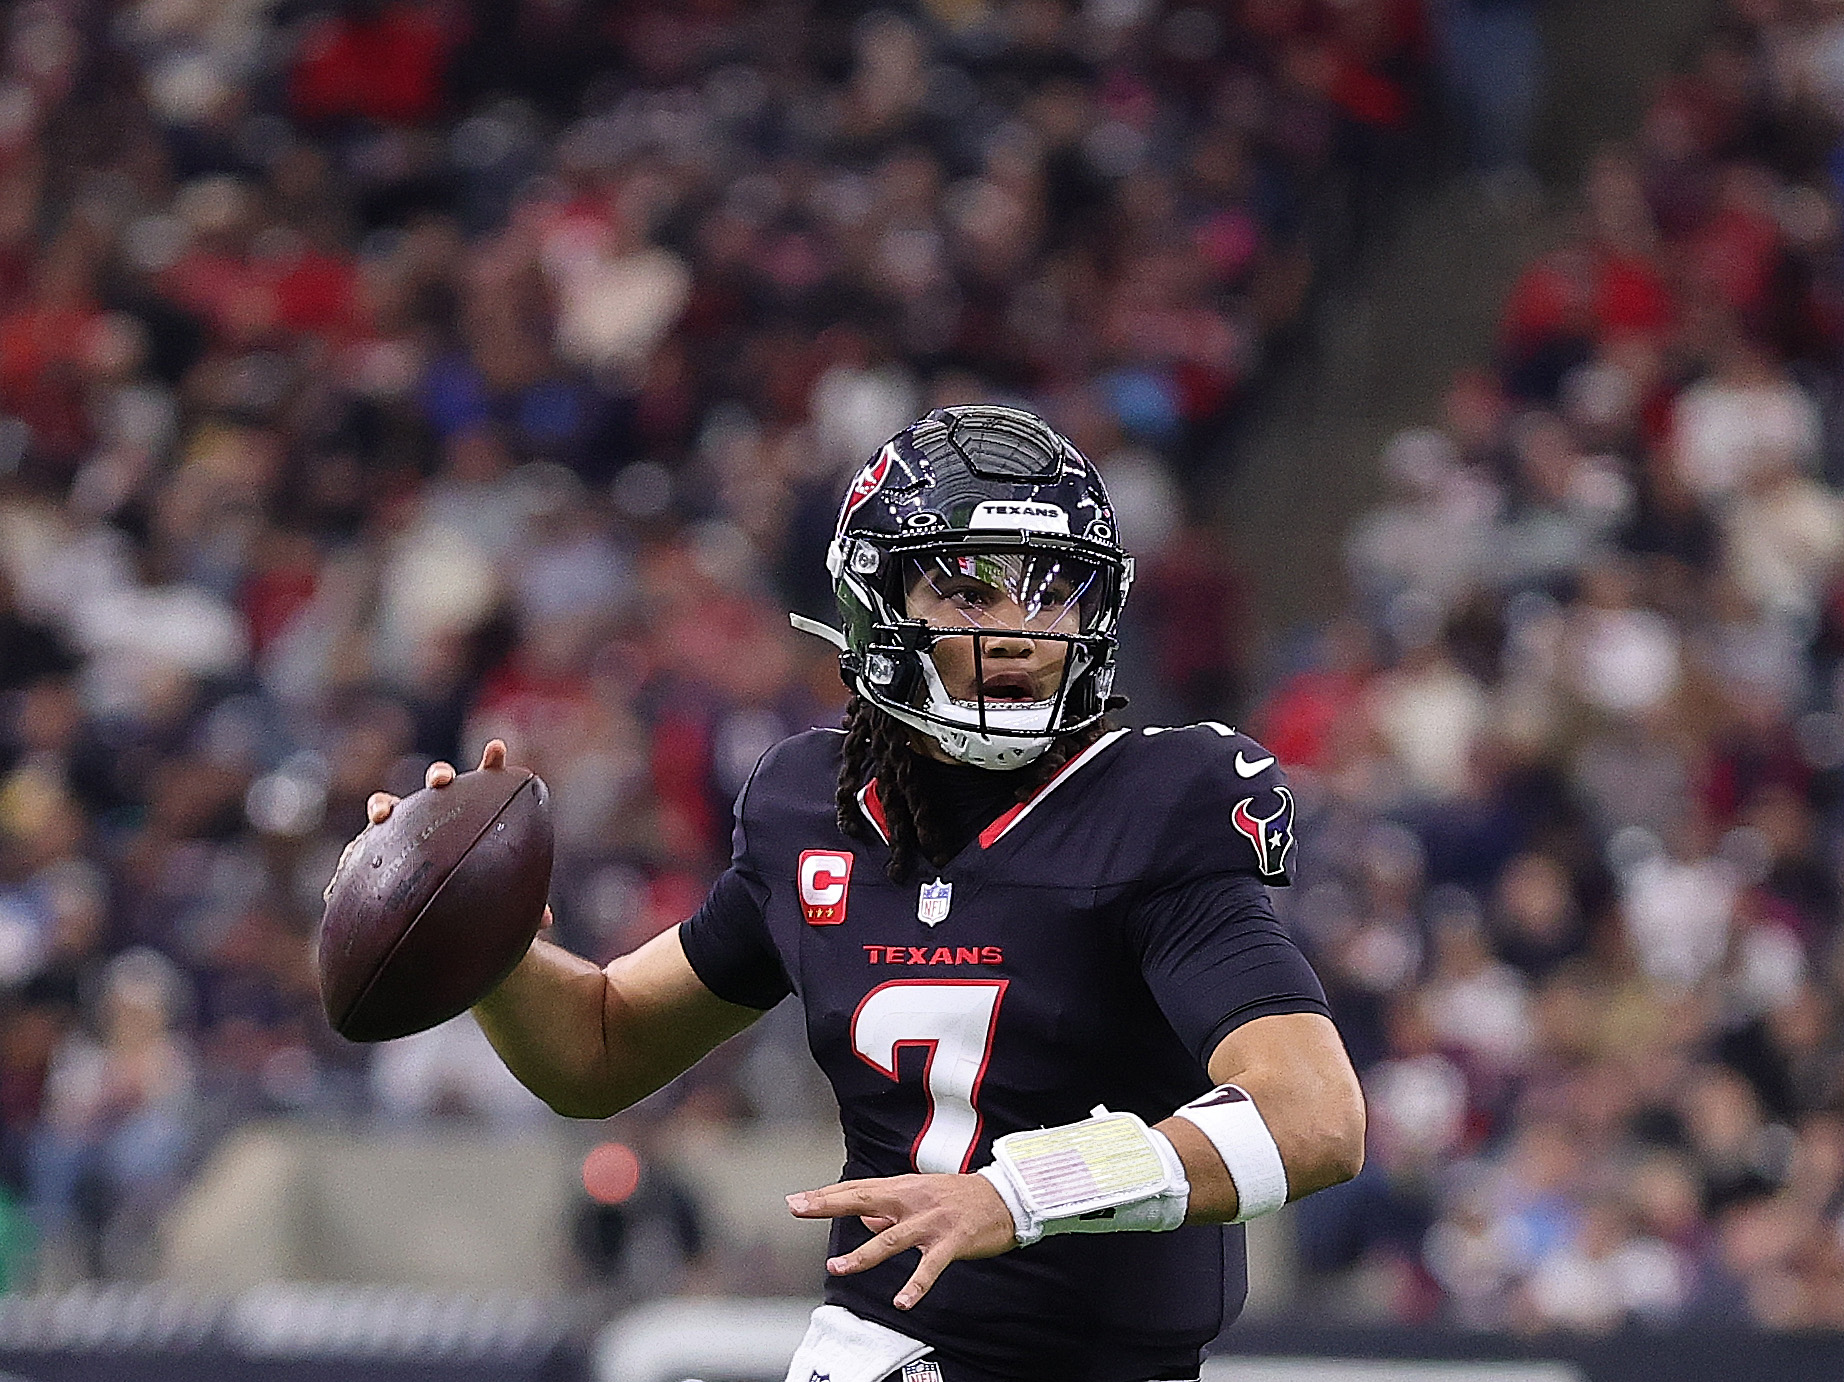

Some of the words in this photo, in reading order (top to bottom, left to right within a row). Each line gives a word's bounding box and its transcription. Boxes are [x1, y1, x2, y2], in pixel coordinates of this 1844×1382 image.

[983, 505, 1059, 518] TEXANS
[800, 855, 847, 906] C
[923, 899, 943, 918] NFL
[862, 944, 1004, 966] TEXANS
[850, 978, 1010, 1174] 7
